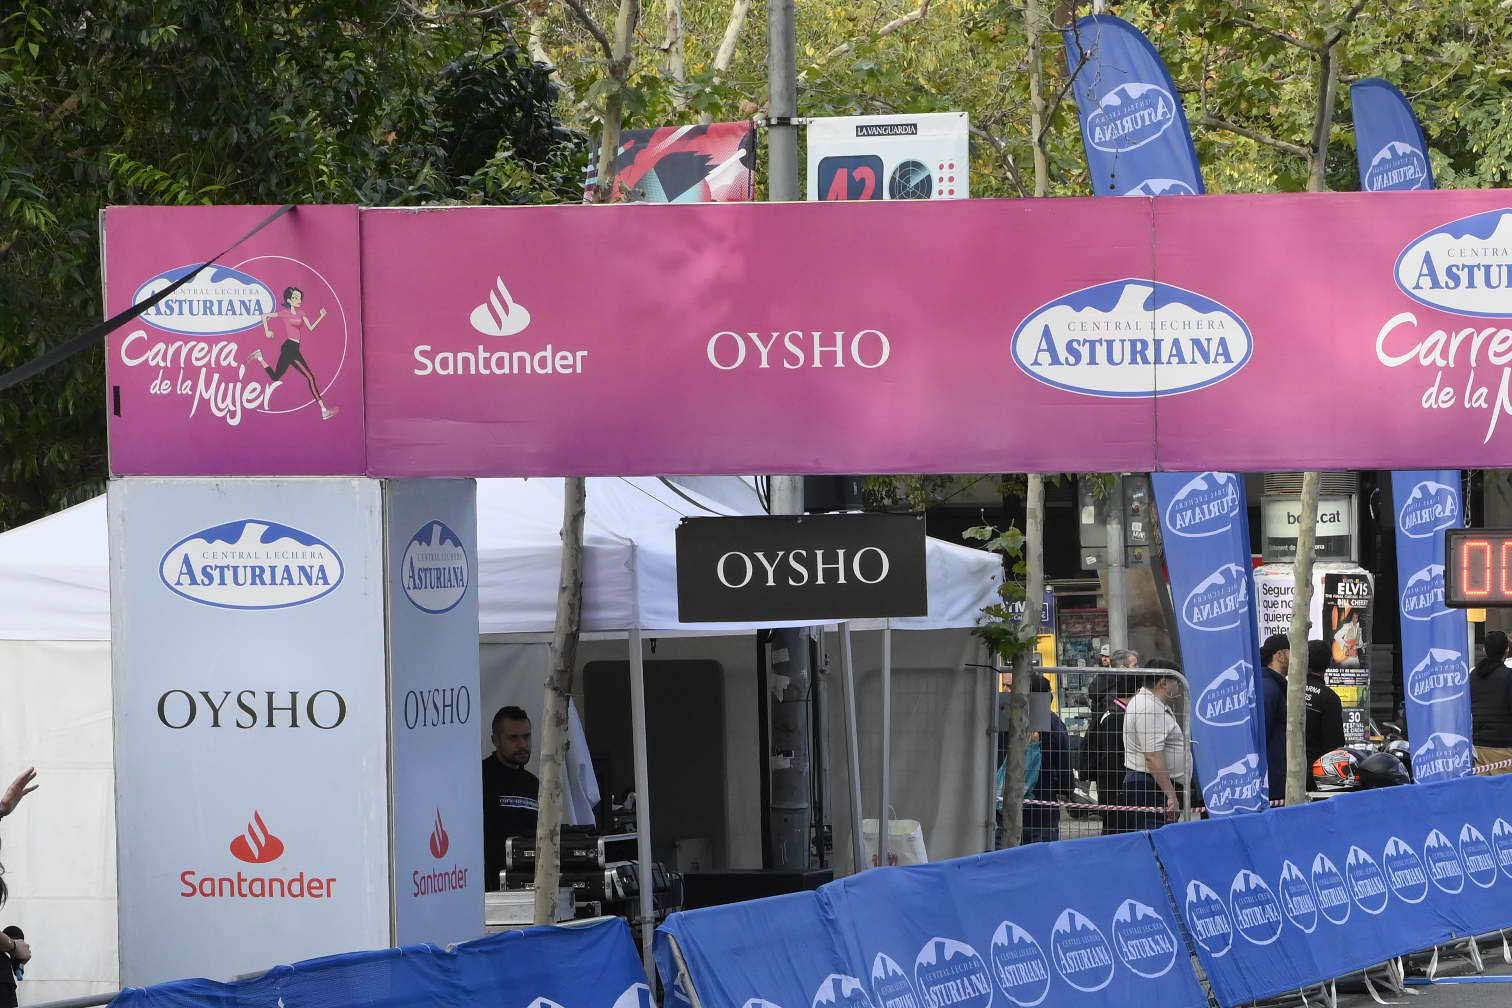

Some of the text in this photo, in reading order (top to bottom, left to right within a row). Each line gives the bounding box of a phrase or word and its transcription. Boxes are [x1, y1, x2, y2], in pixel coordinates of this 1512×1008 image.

[858, 125, 916, 136] LA VANGUARDIA
[1067, 319, 1226, 332] CENTRAL LECHERA
[120, 330, 238, 367] Carrera
[413, 344, 588, 376] Santander
[707, 330, 891, 370] OYSHO
[1030, 324, 1234, 366] ASTURIANA
[150, 365, 283, 426] de la Mujer
[1421, 371, 1456, 409] de
[1463, 369, 1488, 409] la
[174, 553, 331, 588] ASTURIANA
[202, 550, 324, 560] CENTRAL LECHERA
[717, 546, 889, 588] OYSHO
[406, 556, 464, 591] ASTURIANA
[1337, 582, 1368, 595] ELVIS
[1263, 600, 1280, 611] que
[157, 689, 347, 729] OYSHO
[404, 685, 470, 729] OYSHO
[1348, 712, 1360, 723] 30
[180, 870, 336, 898] Santander
[413, 864, 468, 897] Santander
[1057, 942, 1112, 974] ASTURIANA
